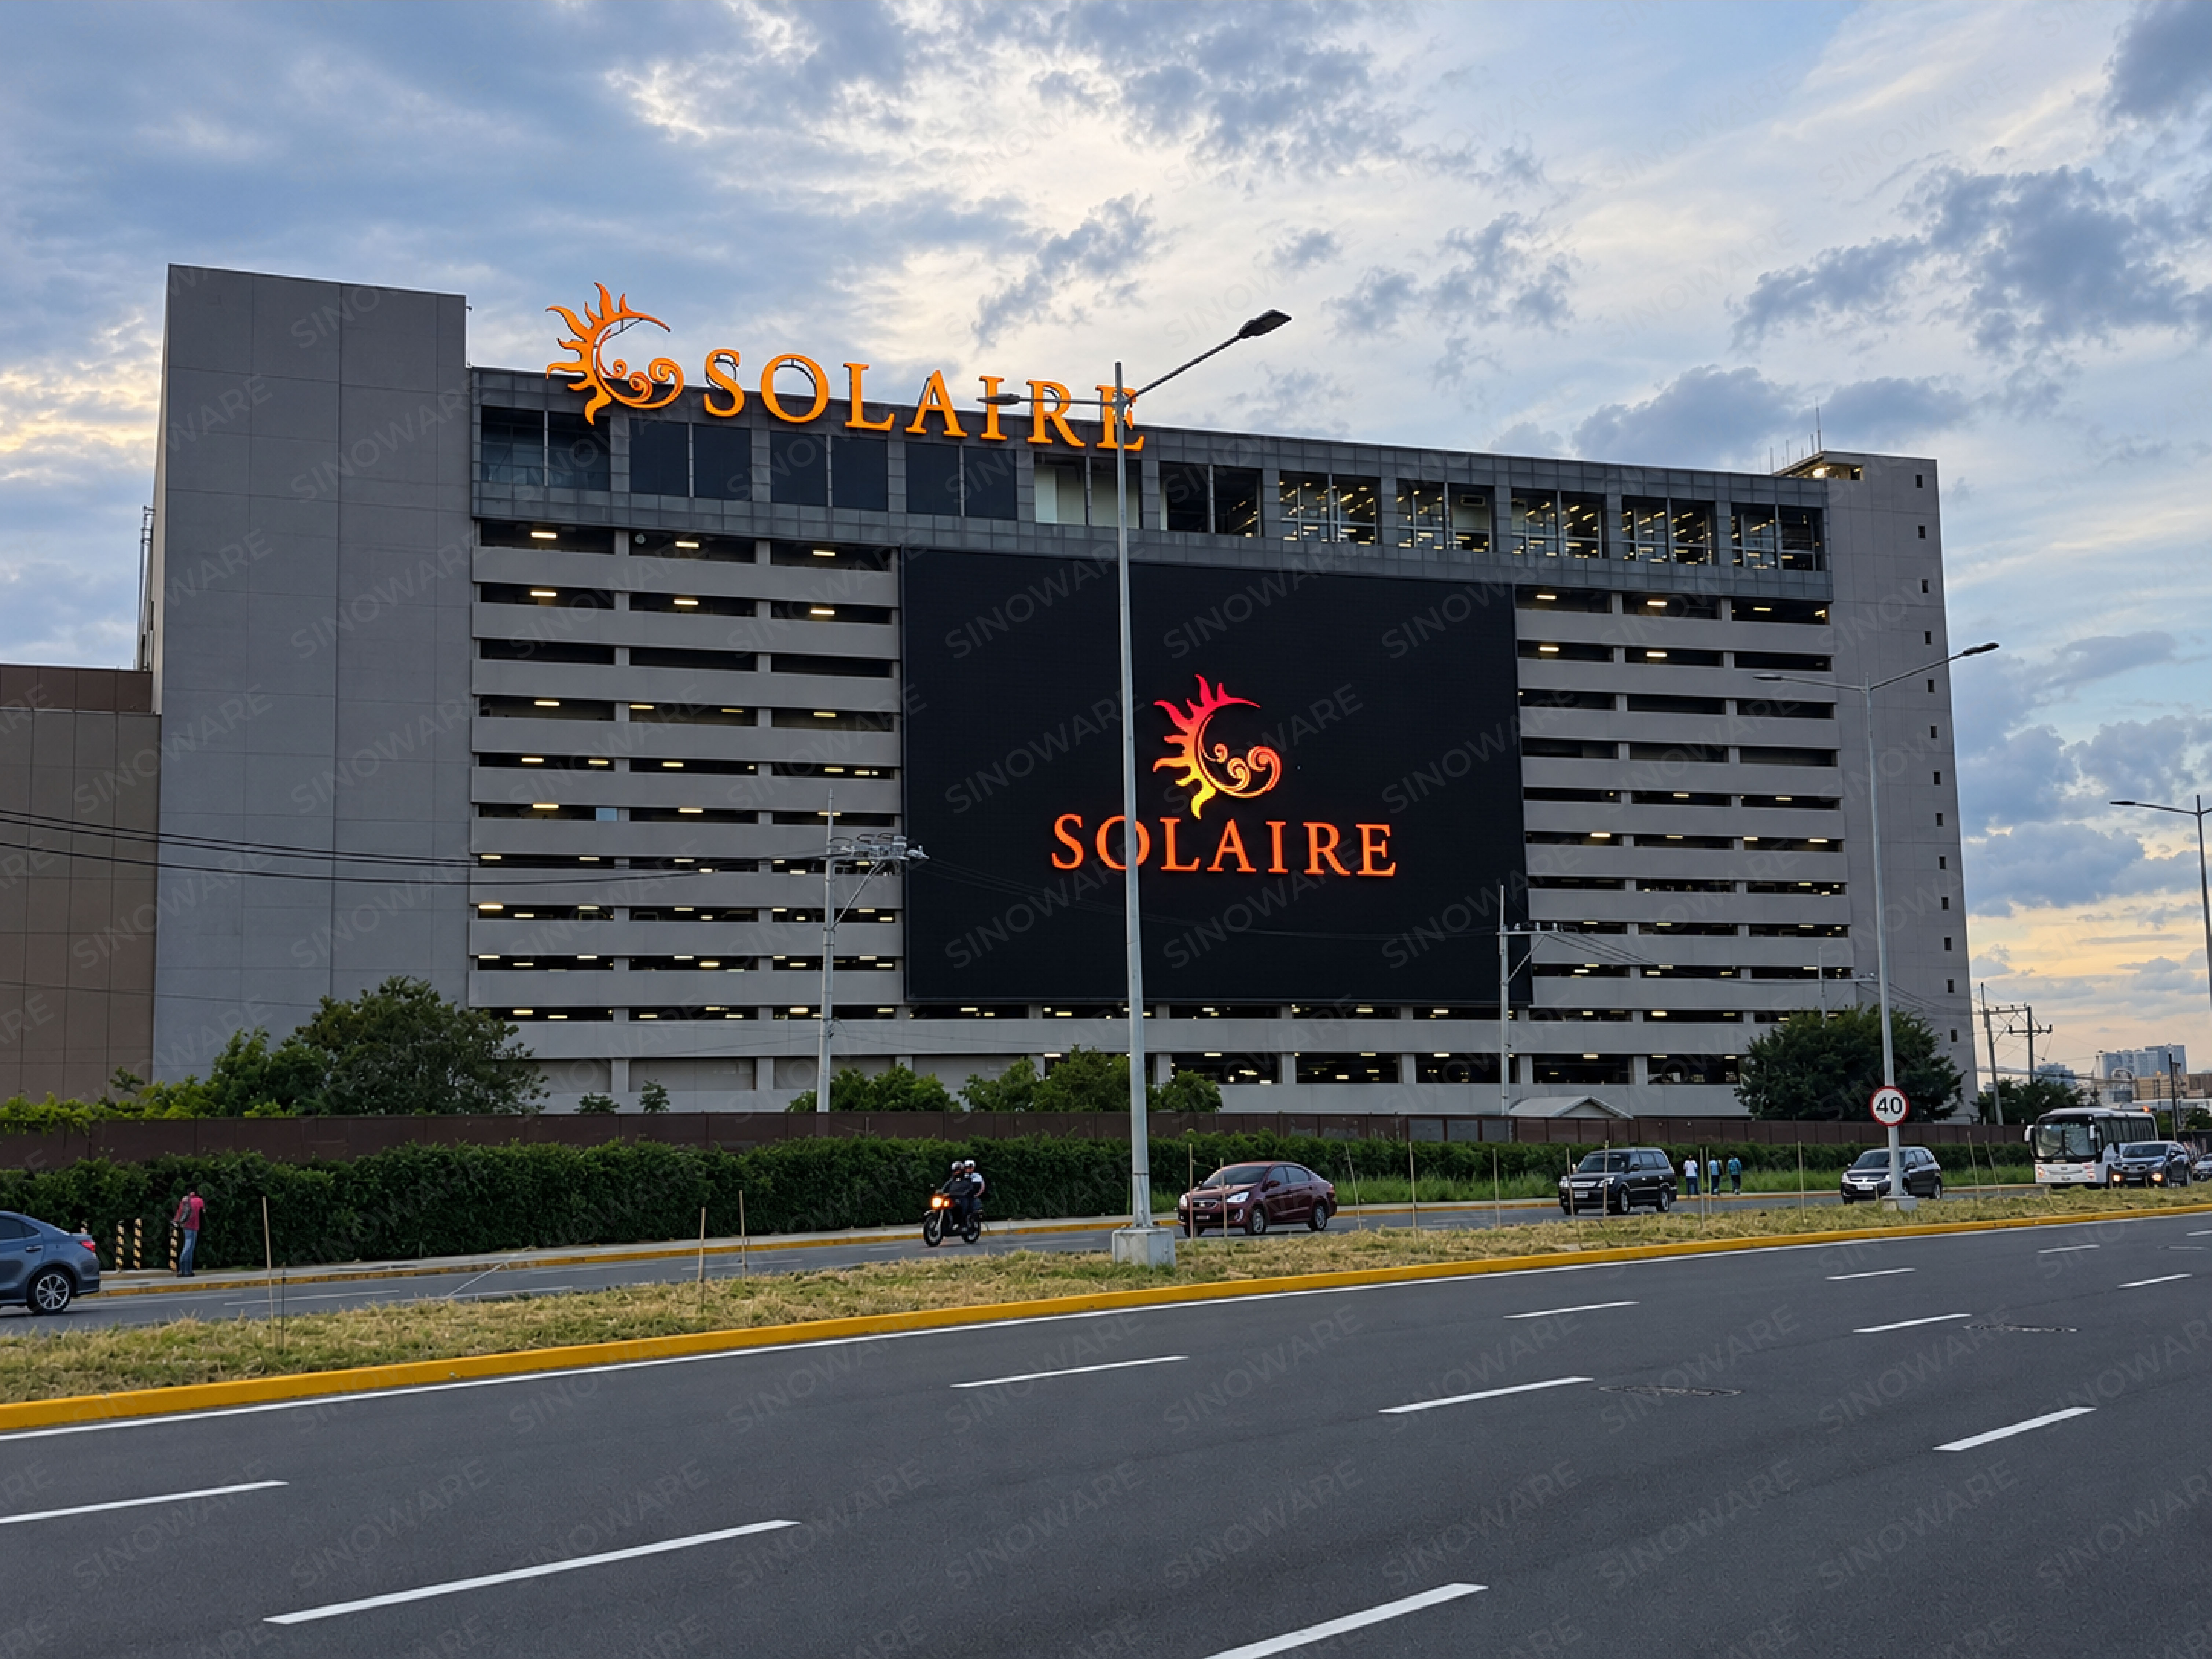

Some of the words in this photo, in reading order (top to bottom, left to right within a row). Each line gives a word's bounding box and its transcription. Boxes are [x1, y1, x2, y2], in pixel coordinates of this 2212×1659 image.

[704, 348, 1144, 451] SOLAIRE
[1052, 814, 1396, 876] SOLAIRE
[1876, 1097, 1902, 1114] 40
